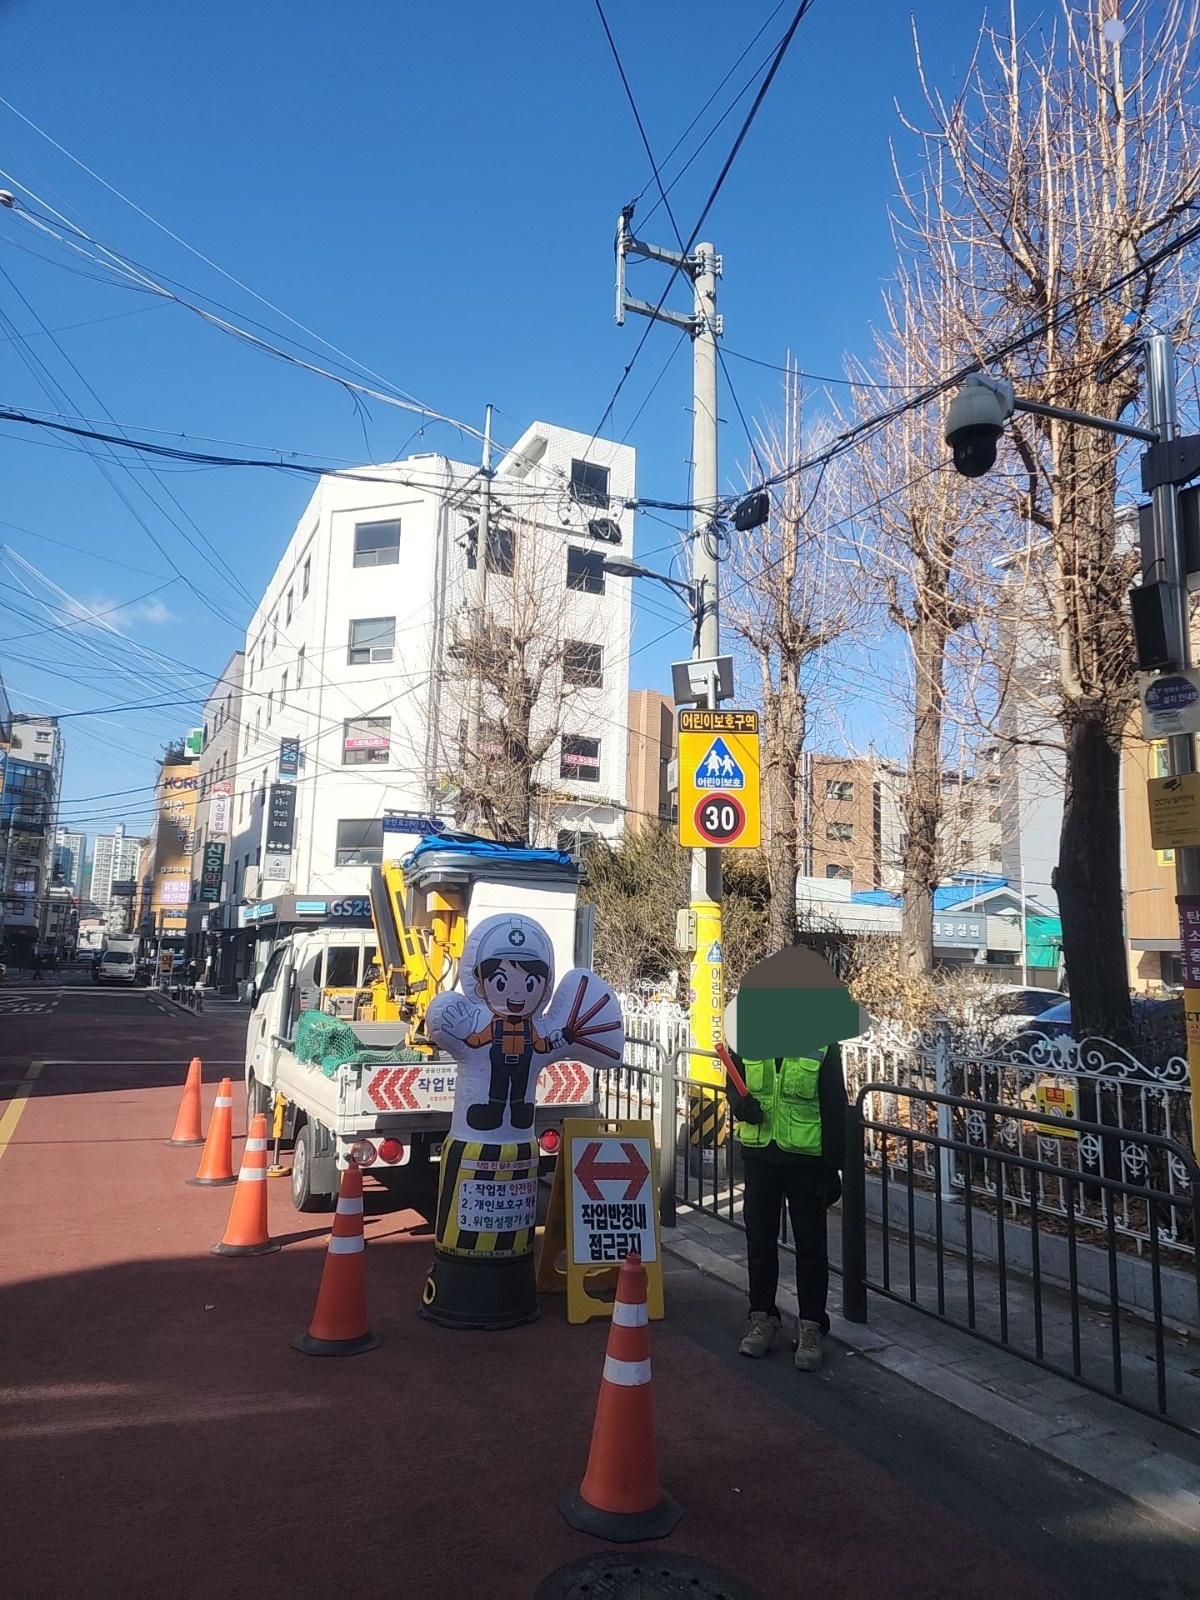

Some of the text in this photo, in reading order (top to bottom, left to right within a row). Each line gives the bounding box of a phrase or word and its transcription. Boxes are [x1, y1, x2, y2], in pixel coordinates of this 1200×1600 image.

[682, 713, 755, 730] 어린이보호구역
[282, 752, 297, 762] 25
[697, 777, 742, 788] 어린이보호
[705, 806, 735, 831] 30
[203, 843, 223, 901] 신유약국
[330, 899, 371, 917] GS25
[711, 1014, 722, 1073] 보호역
[1046, 1089, 1064, 1099] 금연
[462, 1183, 473, 1195] 1.
[475, 1183, 507, 1197] 작업전
[461, 1198, 472, 1211] 2.
[474, 1199, 524, 1213] 개인보호구
[460, 1214, 471, 1227] 3.
[473, 1213, 523, 1229] 위험성평가
[581, 1203, 647, 1231] 작업반경내
[588, 1232, 642, 1261] 접근금지
